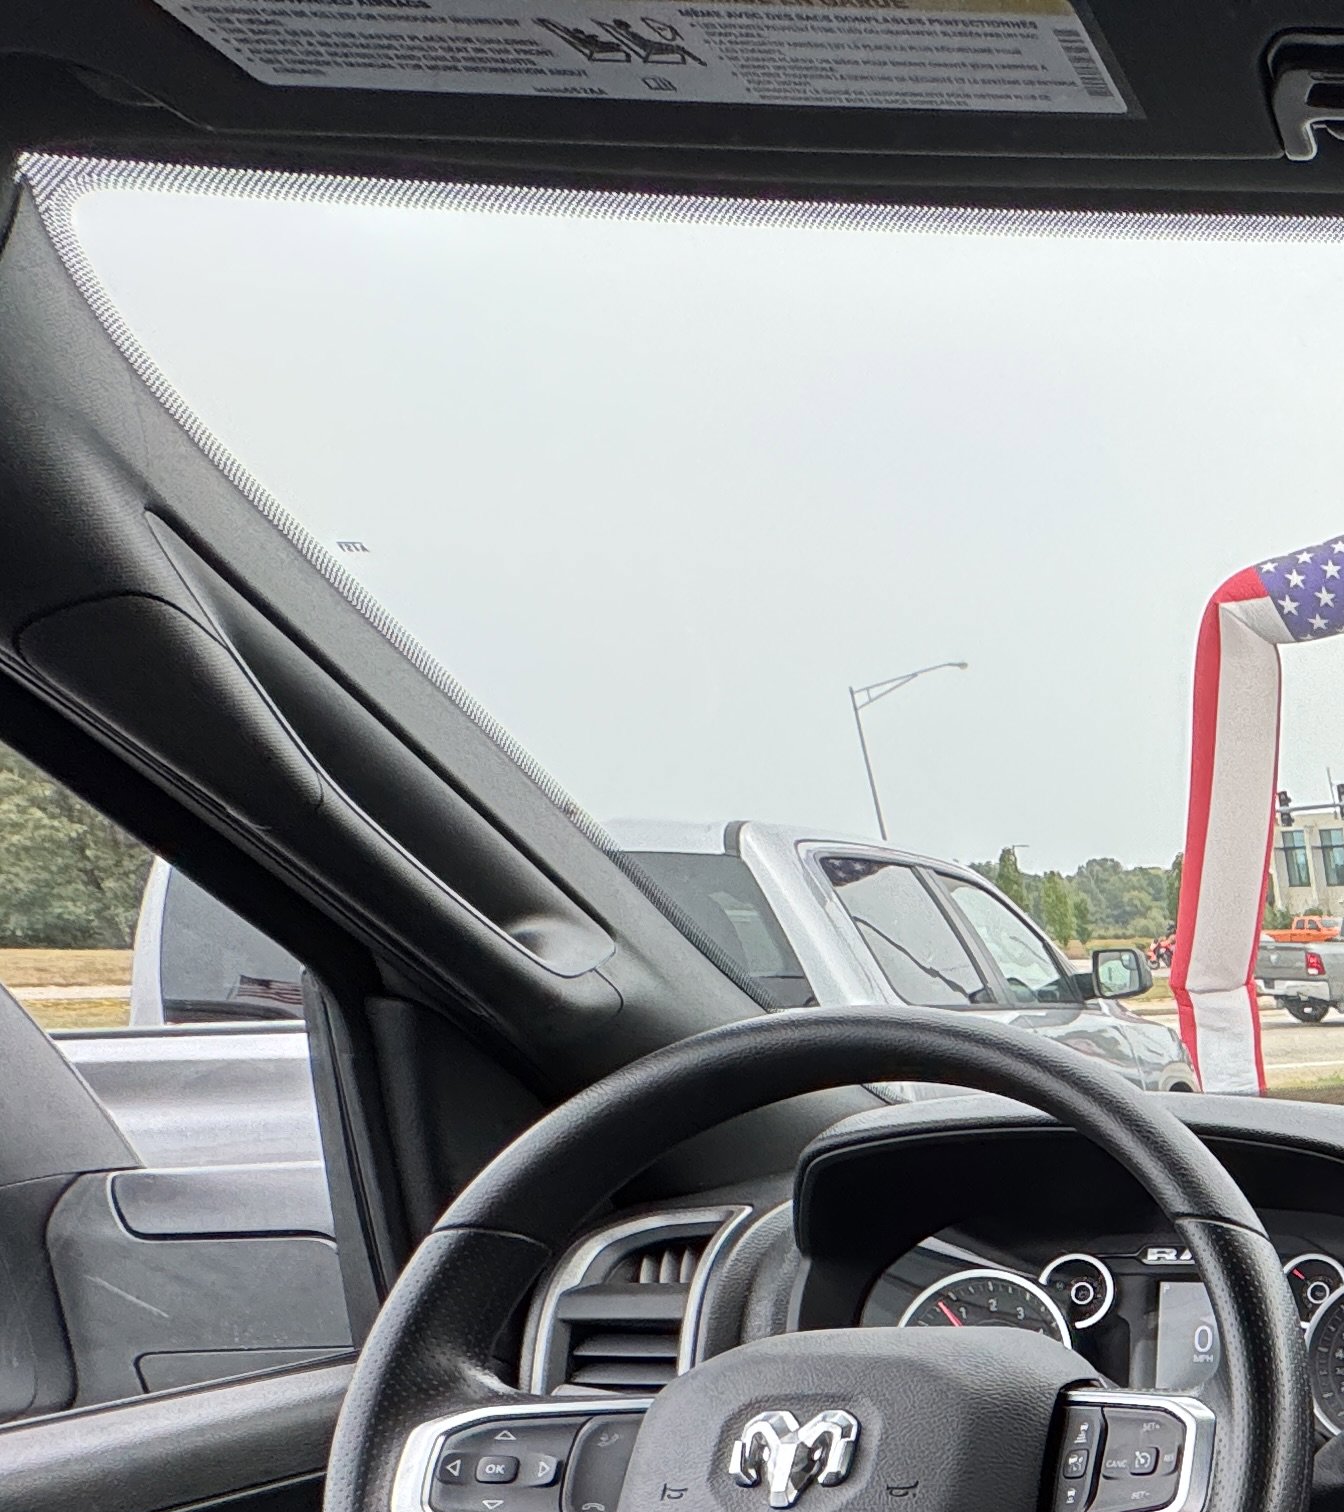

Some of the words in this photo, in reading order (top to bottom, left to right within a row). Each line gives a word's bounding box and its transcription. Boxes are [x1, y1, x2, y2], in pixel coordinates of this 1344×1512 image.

[1147, 1248, 1193, 1261] RA
[989, 1299, 998, 1310] 2
[1016, 1307, 1025, 1319] 3
[1194, 1324, 1213, 1353] 0
[1193, 1354, 1213, 1363] MPH
[1106, 1459, 1127, 1468] CANC
[485, 1464, 506, 1475] OK
